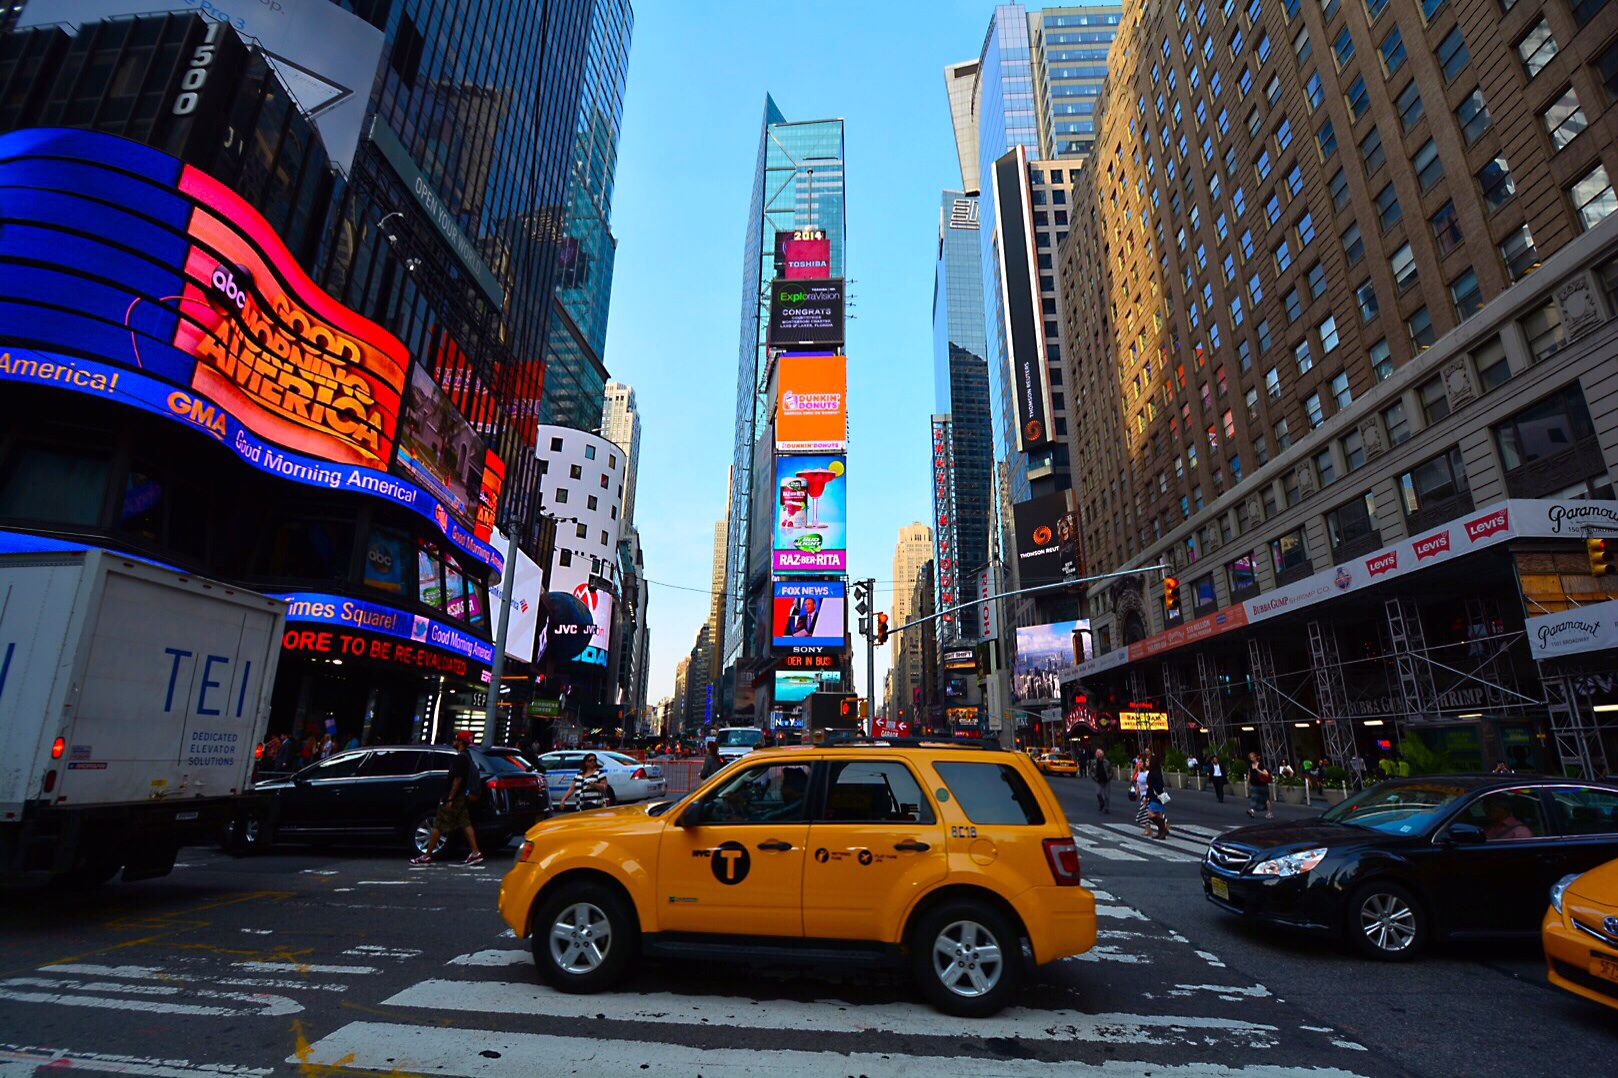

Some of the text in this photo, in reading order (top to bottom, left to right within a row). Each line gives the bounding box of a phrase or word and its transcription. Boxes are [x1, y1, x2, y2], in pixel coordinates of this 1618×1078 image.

[200, 0, 246, 30] Pro 3
[172, 23, 219, 116] 1500
[415, 177, 438, 215] OPEN
[438, 207, 457, 243] YOUR
[794, 231, 823, 241] 2014
[212, 271, 246, 309] abc
[780, 291, 841, 303] ExploraVision
[782, 308, 832, 316] CONGRATS
[274, 293, 361, 366] GOOD
[0, 352, 119, 394] America!
[196, 319, 382, 450] AMERICA
[799, 394, 840, 402] DUNKIN'
[167, 391, 227, 436] GMA
[235, 429, 417, 505] Good Morning America!
[934, 428, 945, 499] ERNST
[938, 513, 948, 526] &
[1548, 505, 1618, 534] Paramou
[368, 548, 392, 567] abc
[452, 525, 467, 546] Good
[466, 536, 491, 564] Morning
[1020, 545, 1060, 559] THOMSON REUT
[781, 586, 829, 595] FOX NEWS
[981, 573, 991, 637] RICOH
[1252, 602, 1272, 616] BUBBA
[1270, 596, 1289, 609] GUMP
[1288, 591, 1316, 604] SHRIMP
[285, 597, 397, 630] imes Square!
[431, 625, 451, 645] Good
[451, 631, 473, 657] Morning
[554, 624, 578, 635] JVC
[1538, 621, 1601, 650] Paramount
[1562, 636, 1590, 645] BROADWAY
[281, 630, 333, 652] ORE
[340, 634, 366, 656] TO
[370, 640, 392, 660] BE
[164, 647, 251, 718] TEI
[473, 692, 487, 707] SEP
[1348, 699, 1379, 716] BUBBA
[190, 744, 236, 754] ELEVATOR
[192, 732, 238, 743] DEDICATED
[188, 756, 235, 766] SOLUTIONS
[720, 850, 743, 880] T
